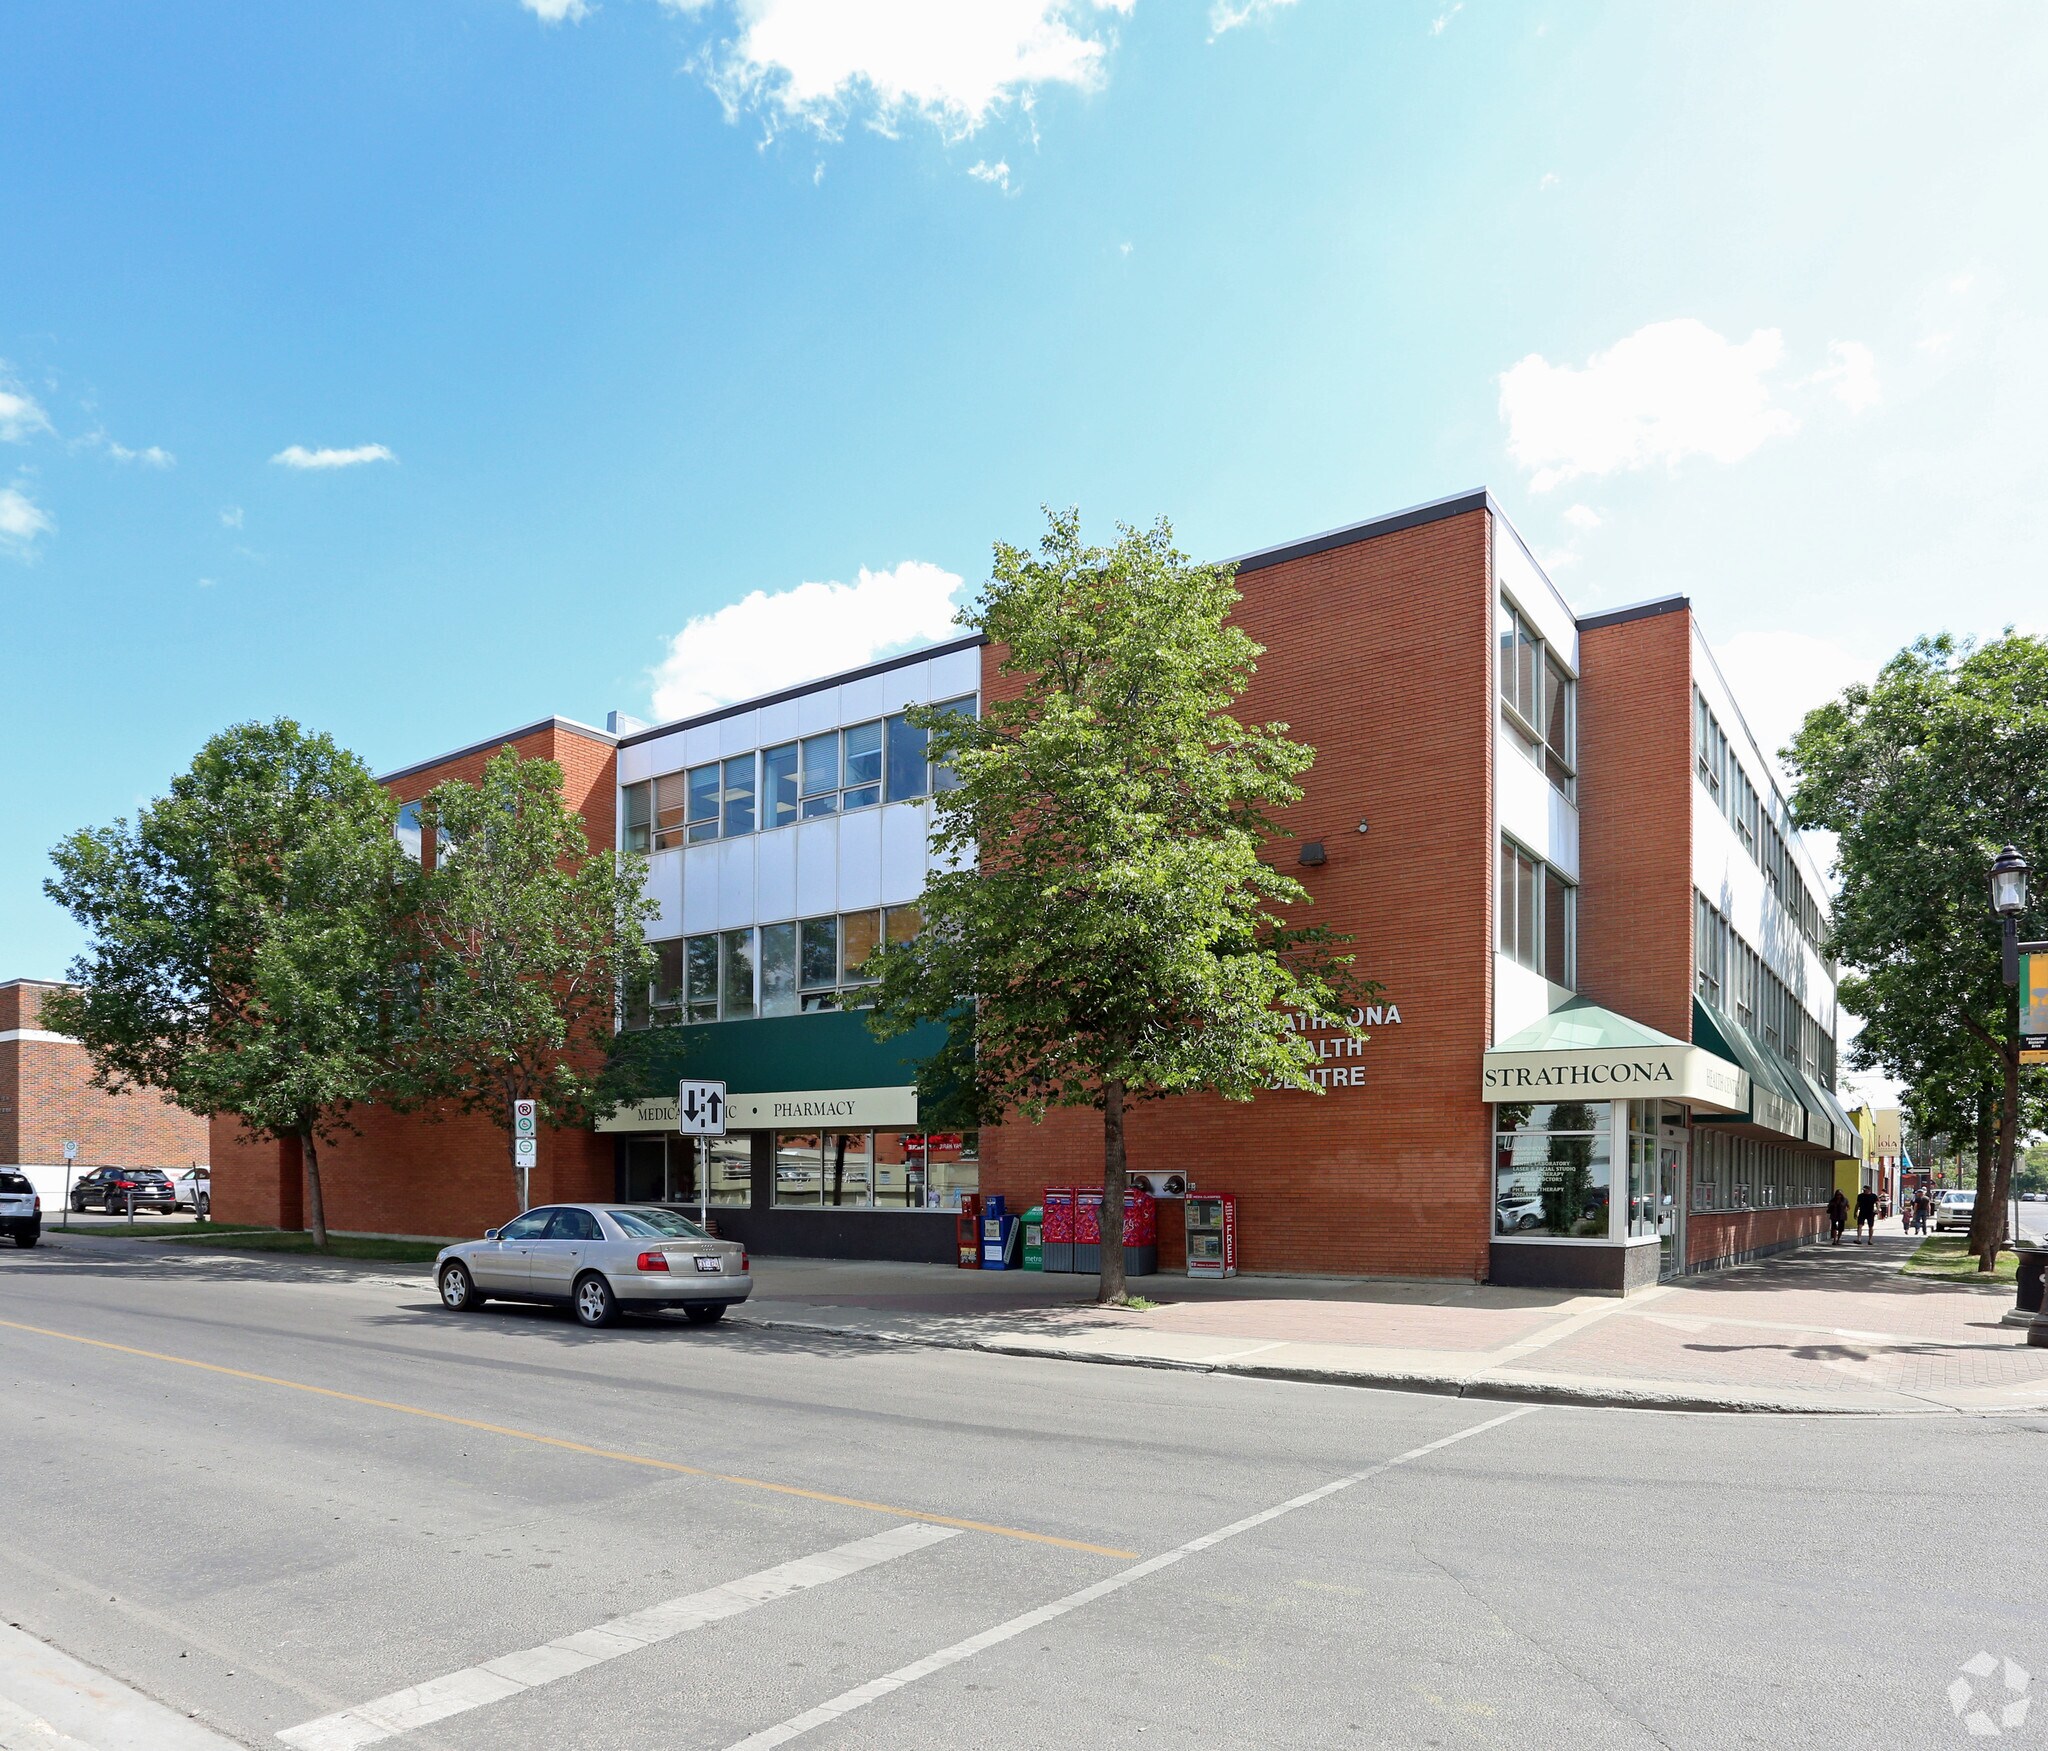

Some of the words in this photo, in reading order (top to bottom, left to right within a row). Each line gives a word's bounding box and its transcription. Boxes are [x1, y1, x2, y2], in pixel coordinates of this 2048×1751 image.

[1266, 1005, 1401, 1032] ATHONA
[1290, 1037, 1362, 1058] ALTH
[1485, 1062, 1674, 1087] STRATHCONA
[638, 1107, 680, 1121] MEDICA
[774, 1101, 855, 1117] PHARMACY
